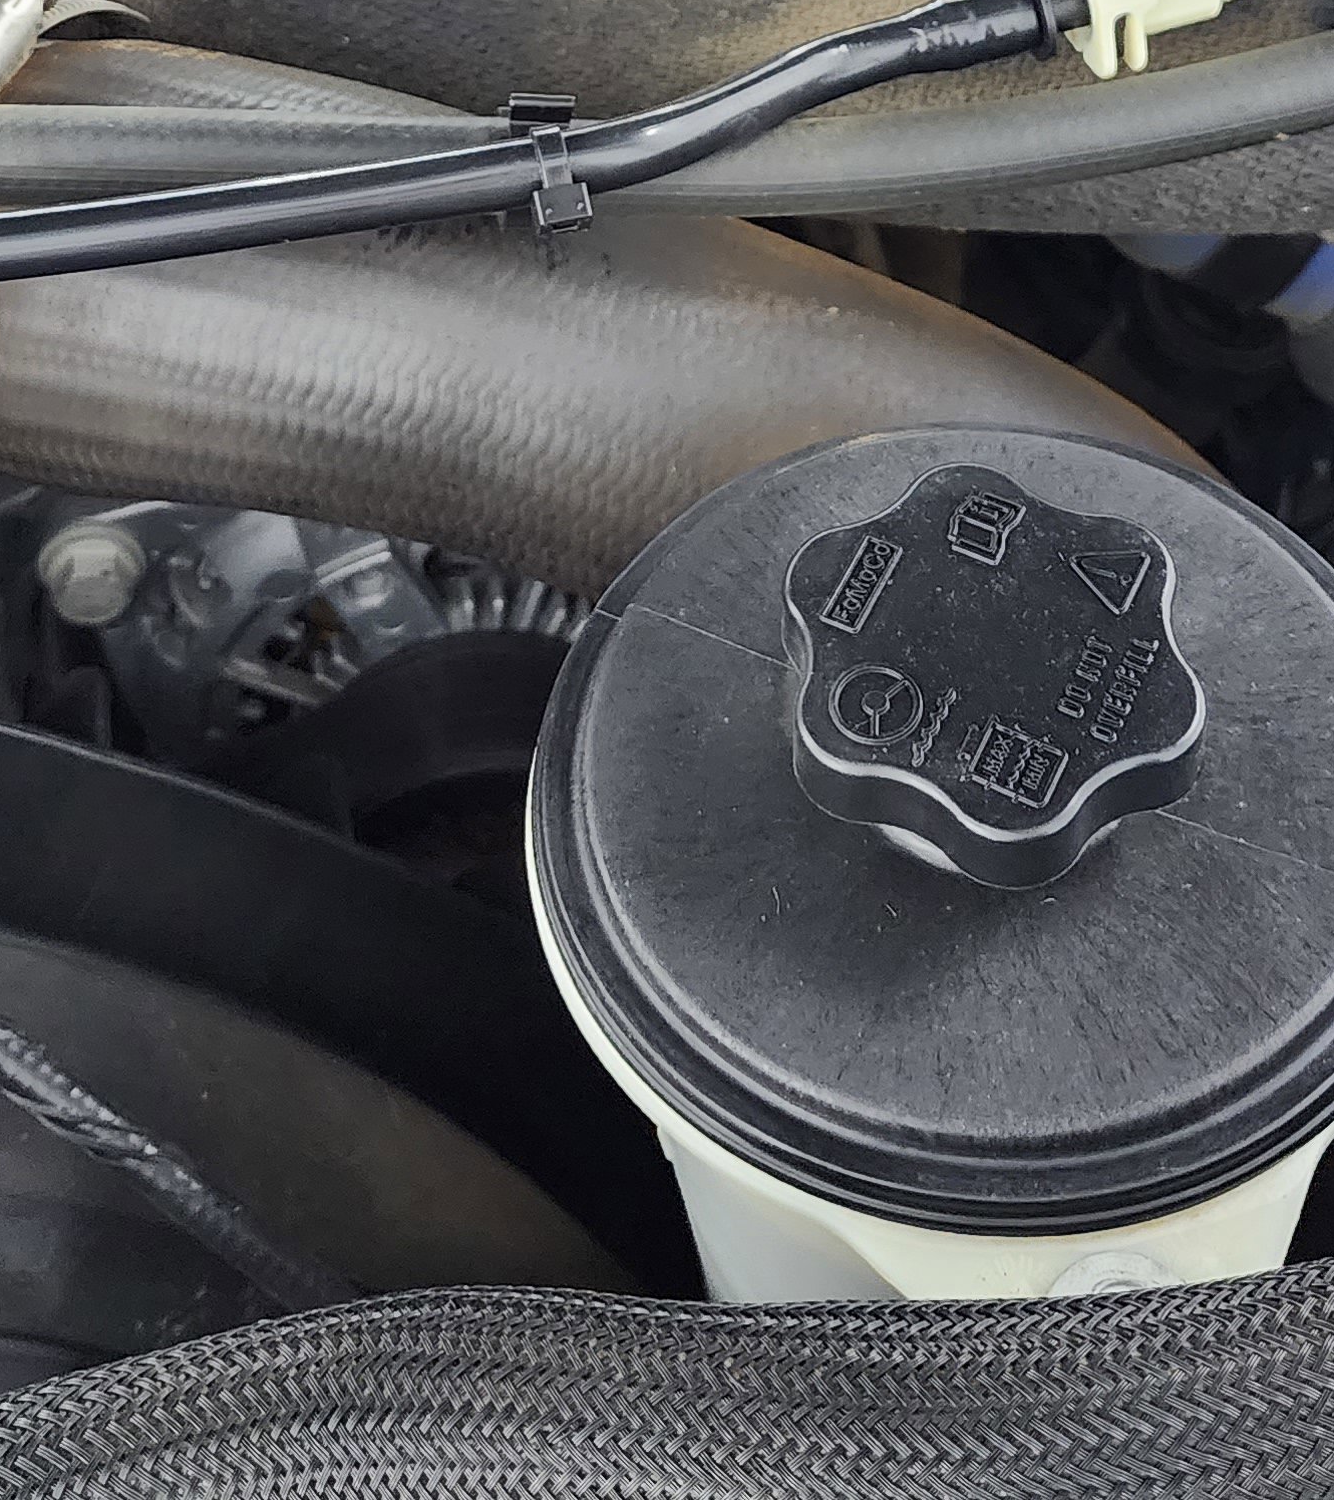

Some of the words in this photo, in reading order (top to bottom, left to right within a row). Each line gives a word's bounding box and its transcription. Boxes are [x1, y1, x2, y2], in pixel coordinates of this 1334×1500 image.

[1057, 682, 1092, 720] DO
[1076, 635, 1114, 684] NOT
[1090, 639, 1160, 743] OVERFILL
[985, 734, 1016, 781] MAX
